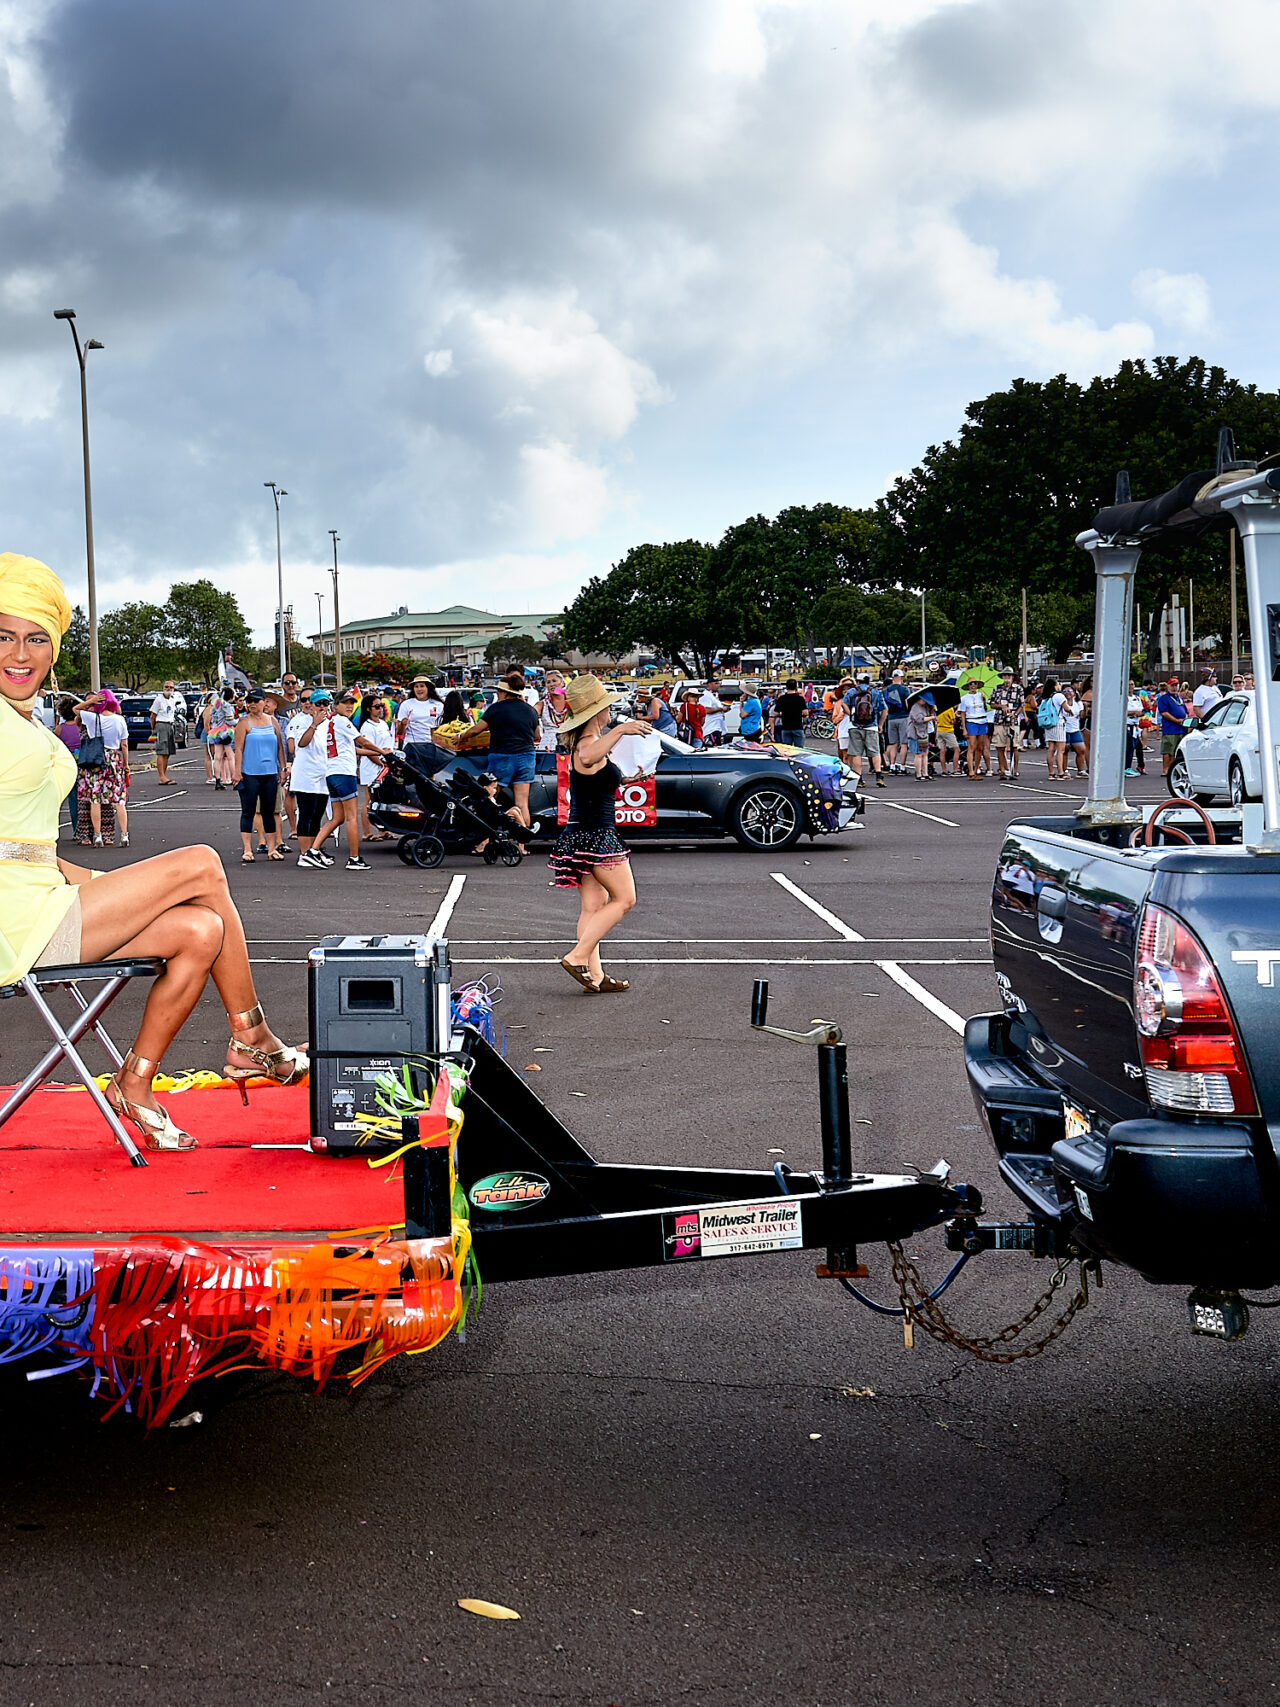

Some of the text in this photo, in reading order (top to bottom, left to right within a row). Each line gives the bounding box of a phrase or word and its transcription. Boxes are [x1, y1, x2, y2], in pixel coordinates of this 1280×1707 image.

[474, 1184, 545, 1203] Tank
[677, 1222, 698, 1234] mts
[703, 1209, 798, 1229] Midwest Trailer
[703, 1226, 738, 1239] SALES
[740, 1226, 748, 1235] &
[751, 1222, 798, 1234] SERVICE
